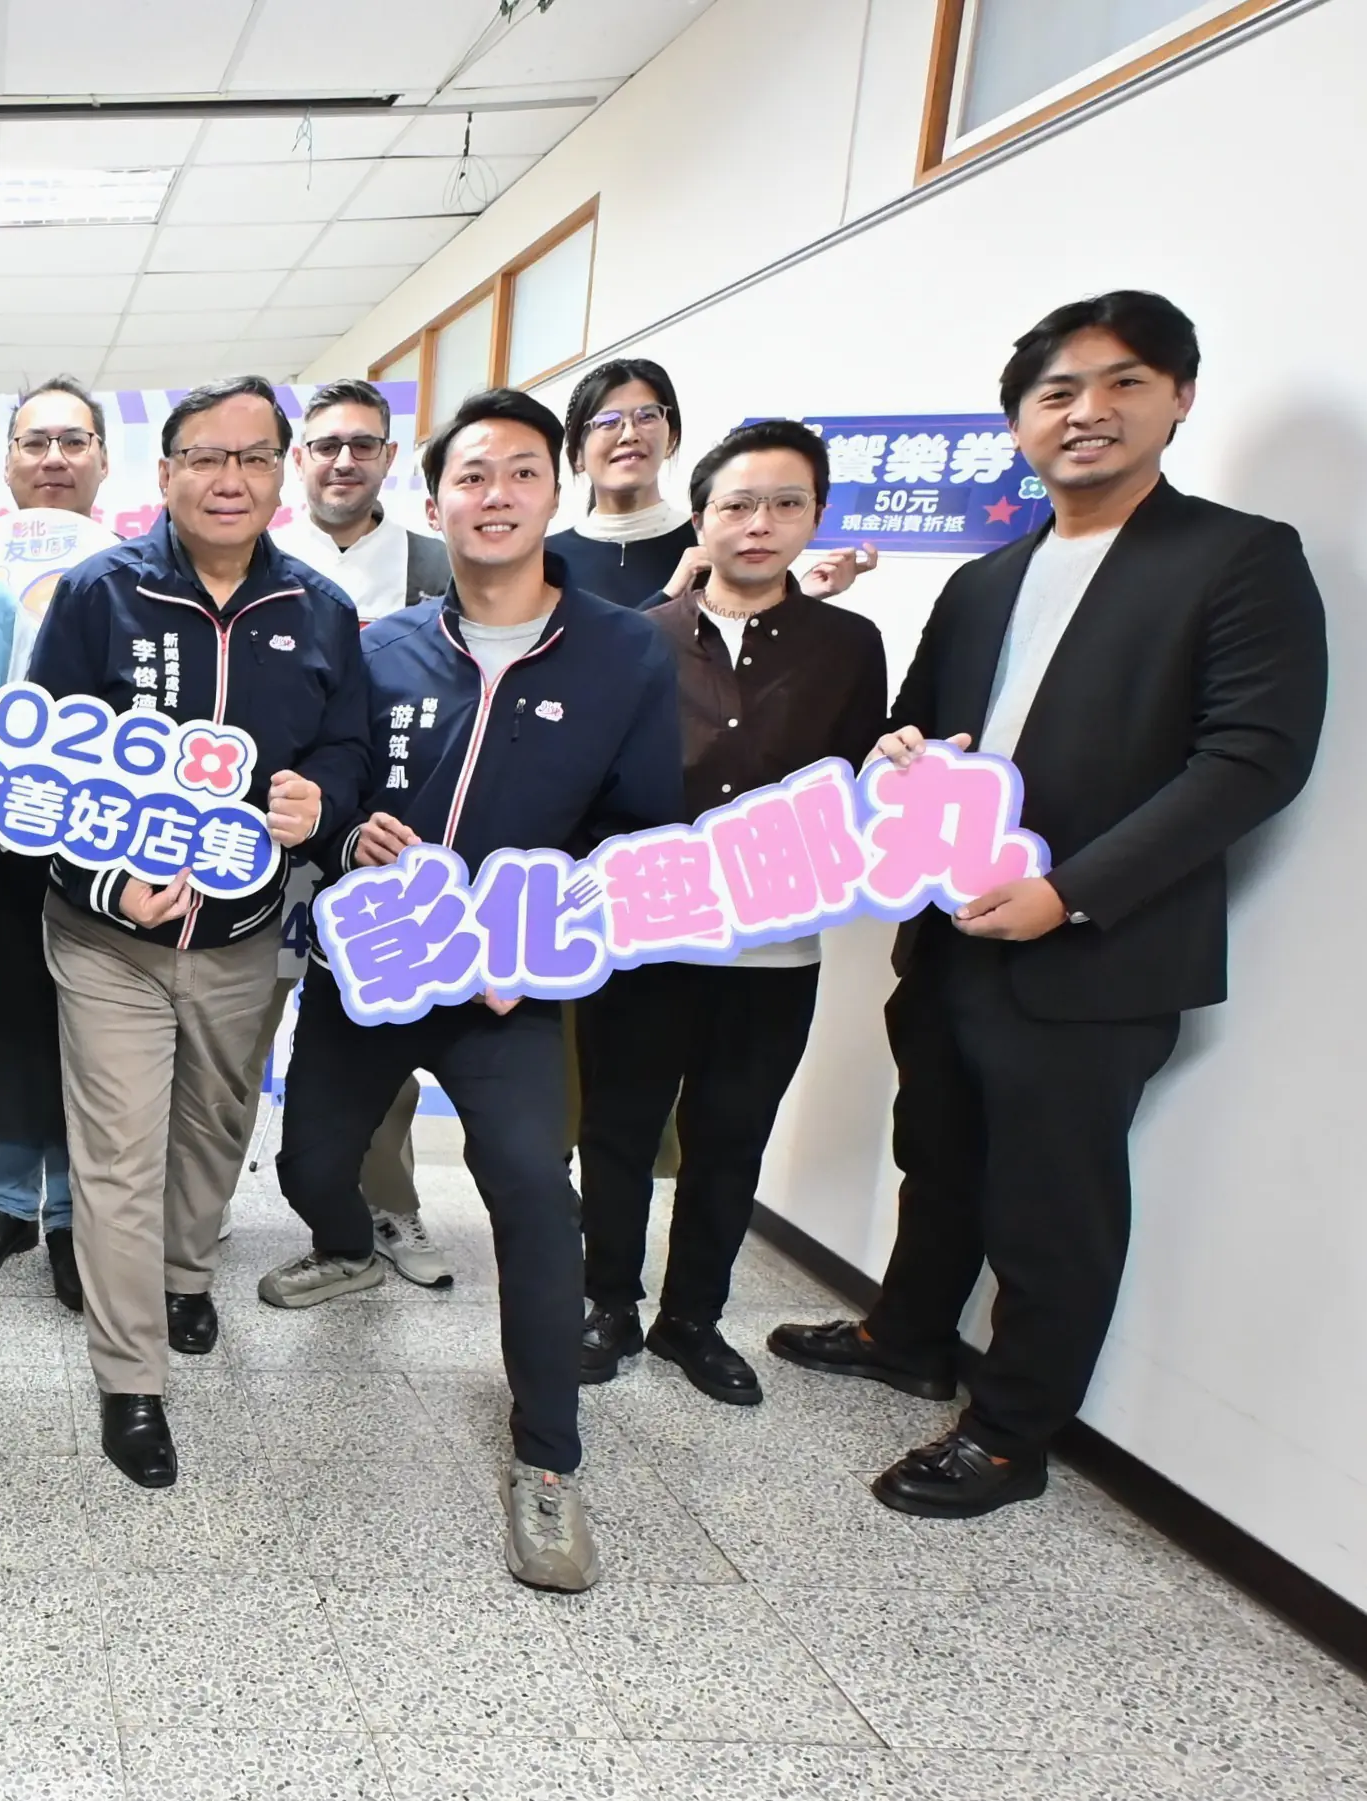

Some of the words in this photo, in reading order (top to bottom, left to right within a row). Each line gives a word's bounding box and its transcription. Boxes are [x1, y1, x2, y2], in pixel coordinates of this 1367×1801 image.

[874, 489, 939, 514] 50元
[841, 514, 965, 533] 現金消費折抵
